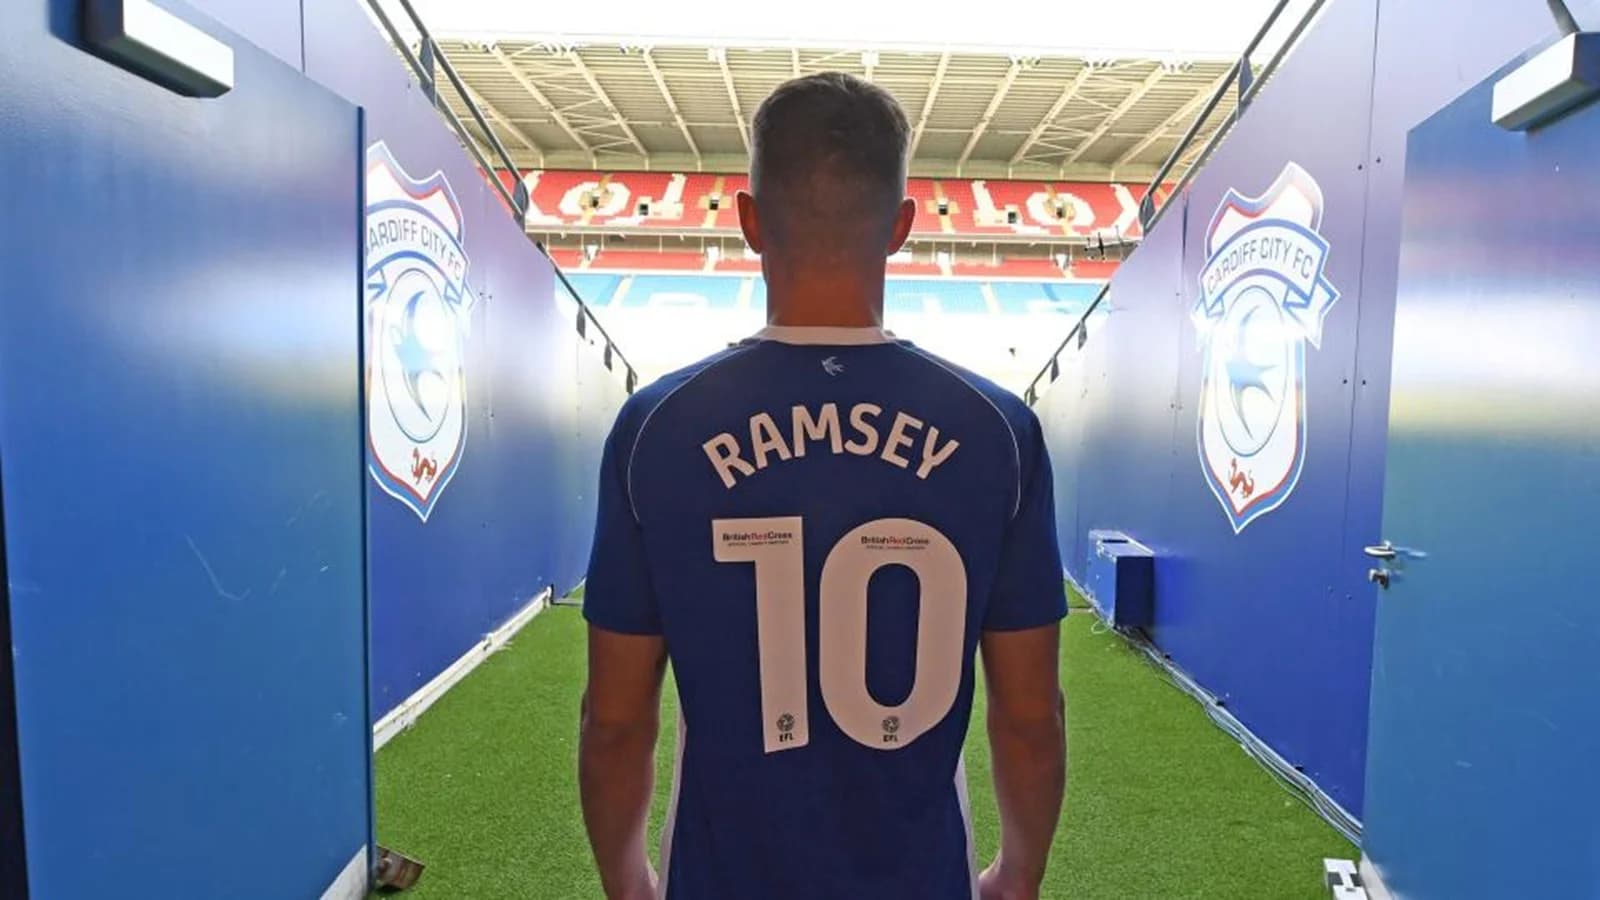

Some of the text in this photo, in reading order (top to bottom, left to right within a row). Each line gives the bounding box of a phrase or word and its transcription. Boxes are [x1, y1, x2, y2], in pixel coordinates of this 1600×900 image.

[366, 218, 462, 281] ARDIFF CITY FC
[1207, 236, 1313, 295] CARDIFF CITY FC
[702, 402, 960, 490] RAMSEY
[711, 515, 968, 754] 10
[778, 732, 794, 743] EFL
[882, 734, 898, 743] EFL
